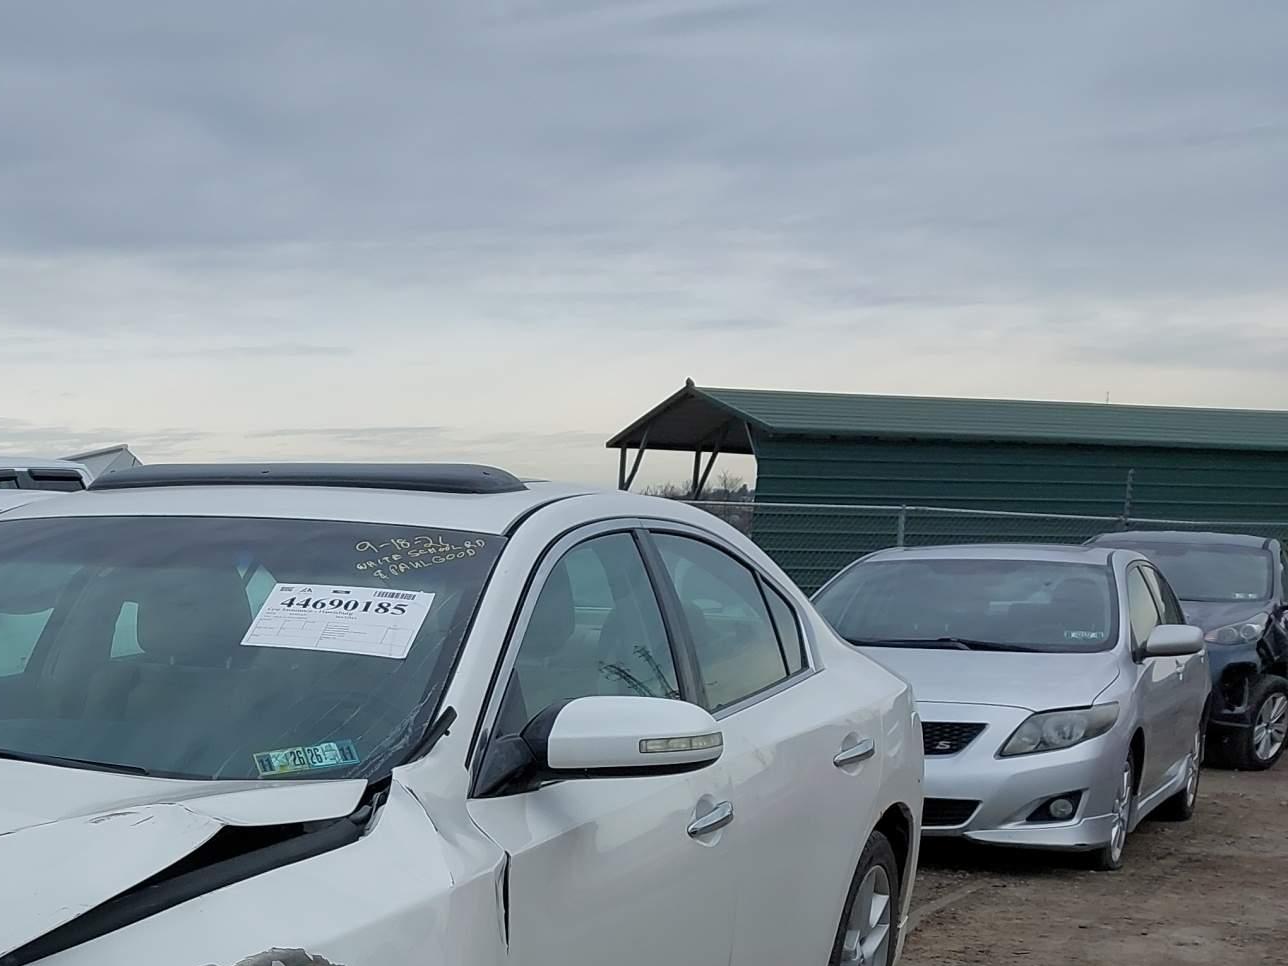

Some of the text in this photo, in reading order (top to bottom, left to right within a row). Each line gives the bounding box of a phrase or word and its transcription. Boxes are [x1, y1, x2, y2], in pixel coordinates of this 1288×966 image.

[280, 596, 409, 616] 44690185
[935, 740, 952, 750] S
[289, 746, 324, 767] 26 26
